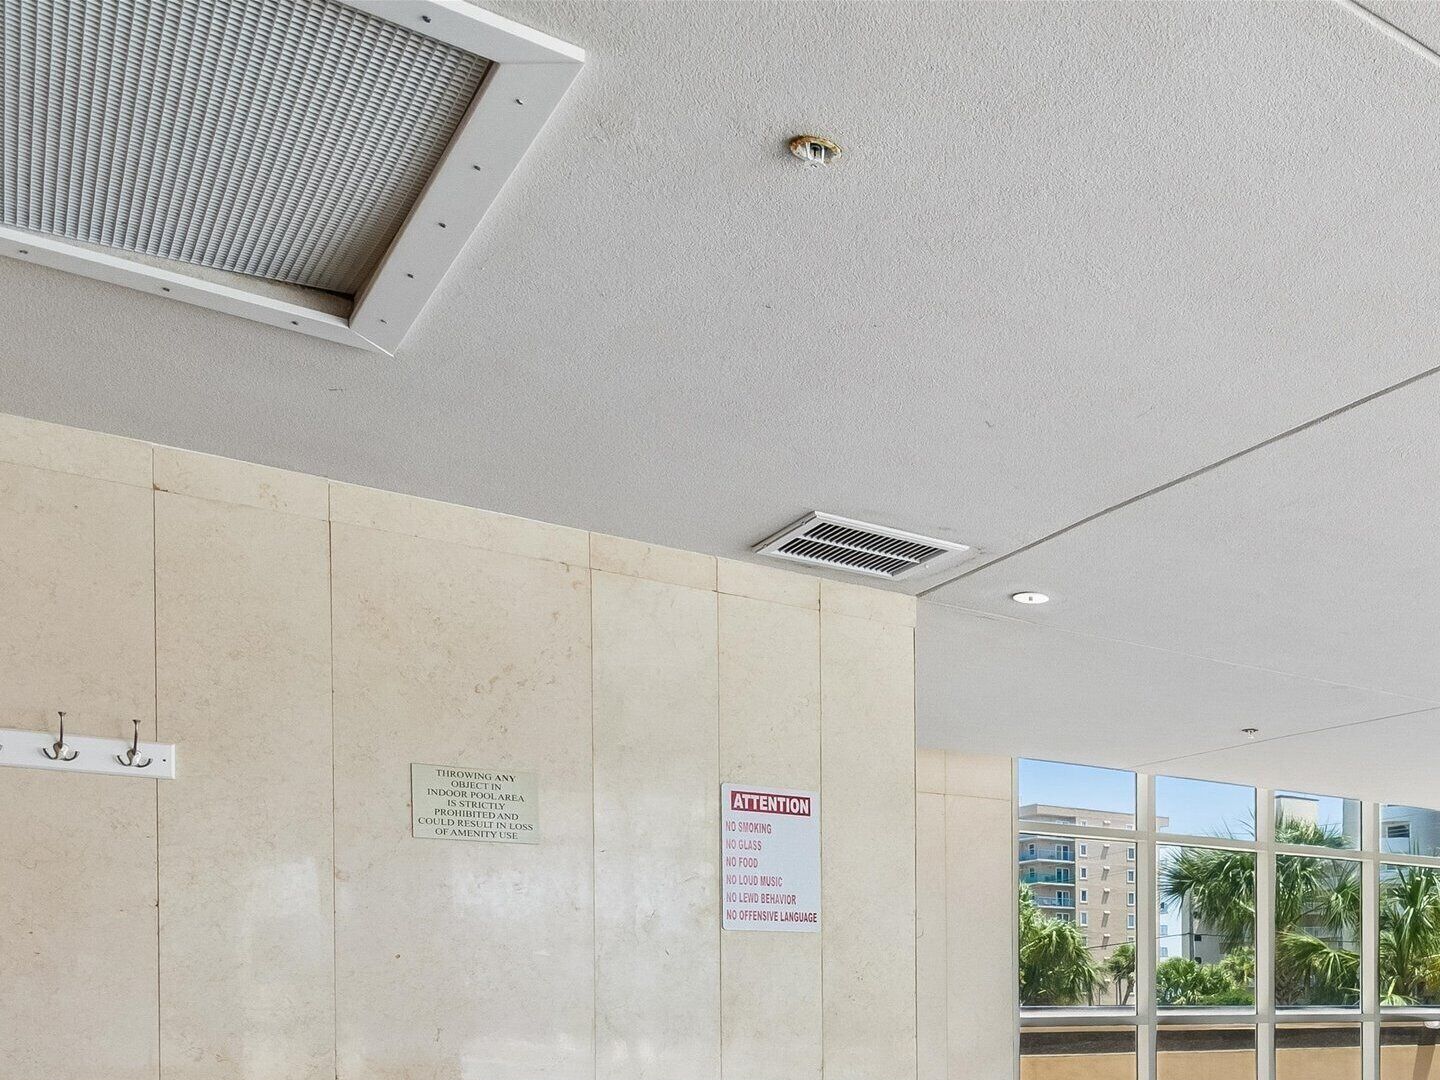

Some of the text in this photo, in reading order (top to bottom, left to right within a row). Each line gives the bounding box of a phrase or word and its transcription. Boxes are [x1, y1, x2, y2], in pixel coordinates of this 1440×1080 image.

[436, 769, 516, 782] THROWING ANY
[451, 781, 488, 790] OBJECT
[427, 789, 524, 802] INDOOR POOL AREA
[460, 801, 505, 810] STRICTLY
[733, 794, 809, 814] ATTENTION
[434, 808, 495, 819] PROHIBITED
[418, 817, 454, 826] COULD
[457, 820, 493, 828] RESULT
[726, 821, 771, 833] NO SMOKING
[450, 829, 497, 838] AMENITY
[726, 839, 761, 850] NO GLASS
[726, 857, 758, 868] NO FOOD
[726, 875, 782, 887] NO LOUD MUSIC
[727, 892, 796, 905] NO LEWD BEHAVIOR
[727, 909, 817, 923] NO OFFENSIVE LANGUAGE
